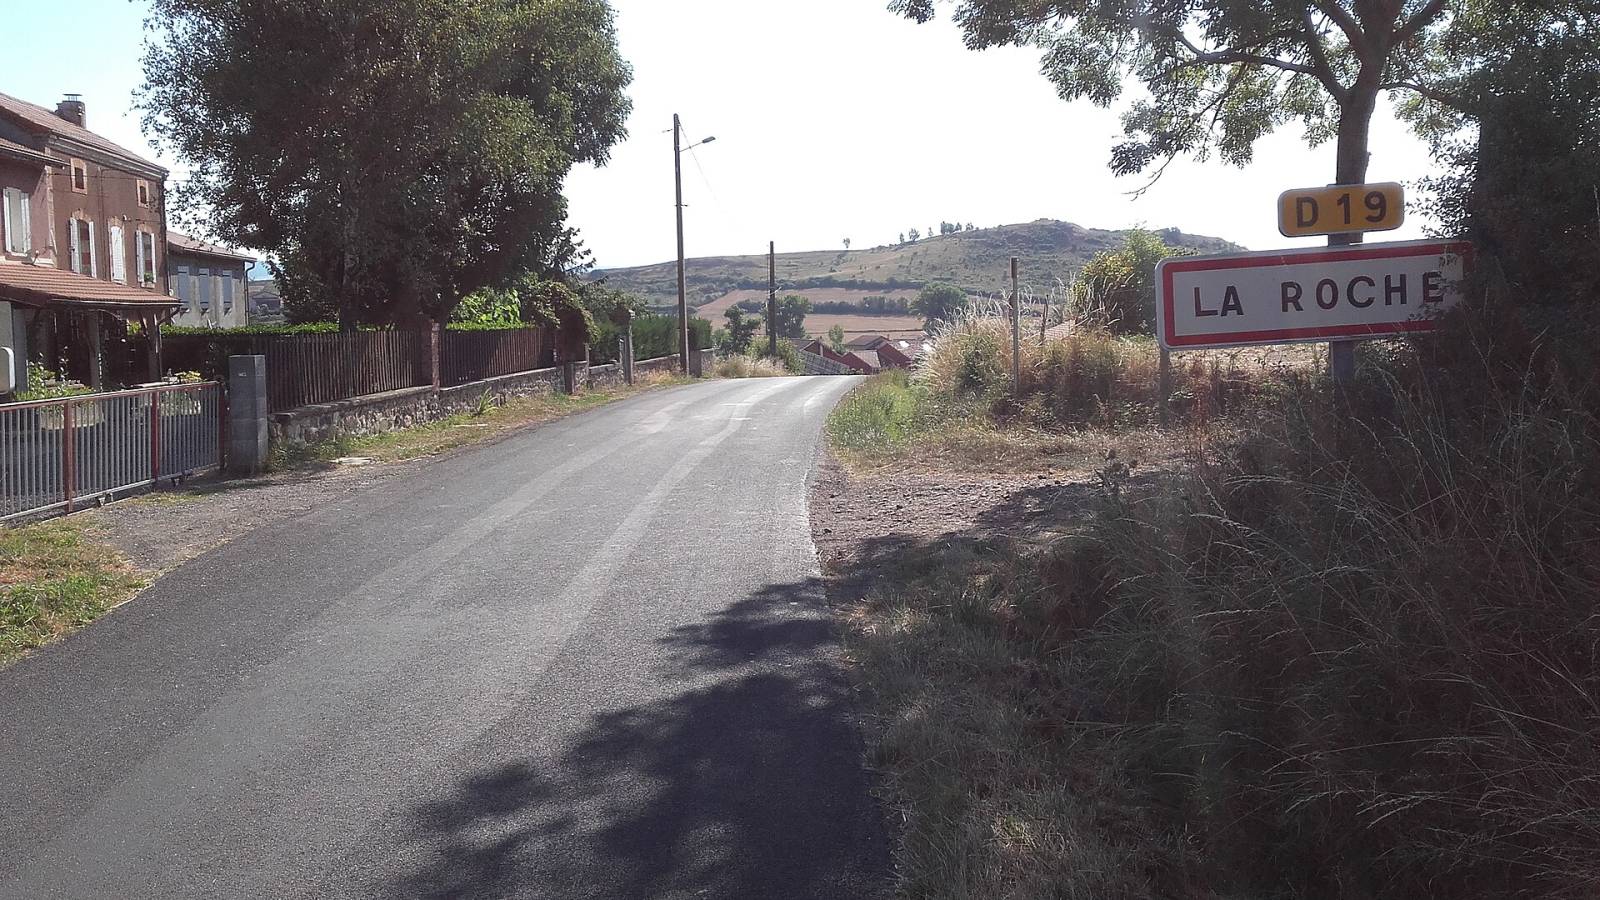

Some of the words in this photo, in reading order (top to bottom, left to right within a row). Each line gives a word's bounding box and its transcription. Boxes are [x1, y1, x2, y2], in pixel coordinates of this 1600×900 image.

[1296, 197, 1318, 228] D
[1337, 191, 1387, 224] 19
[1194, 286, 1244, 317] LA
[1281, 272, 1443, 312] ROCHE
